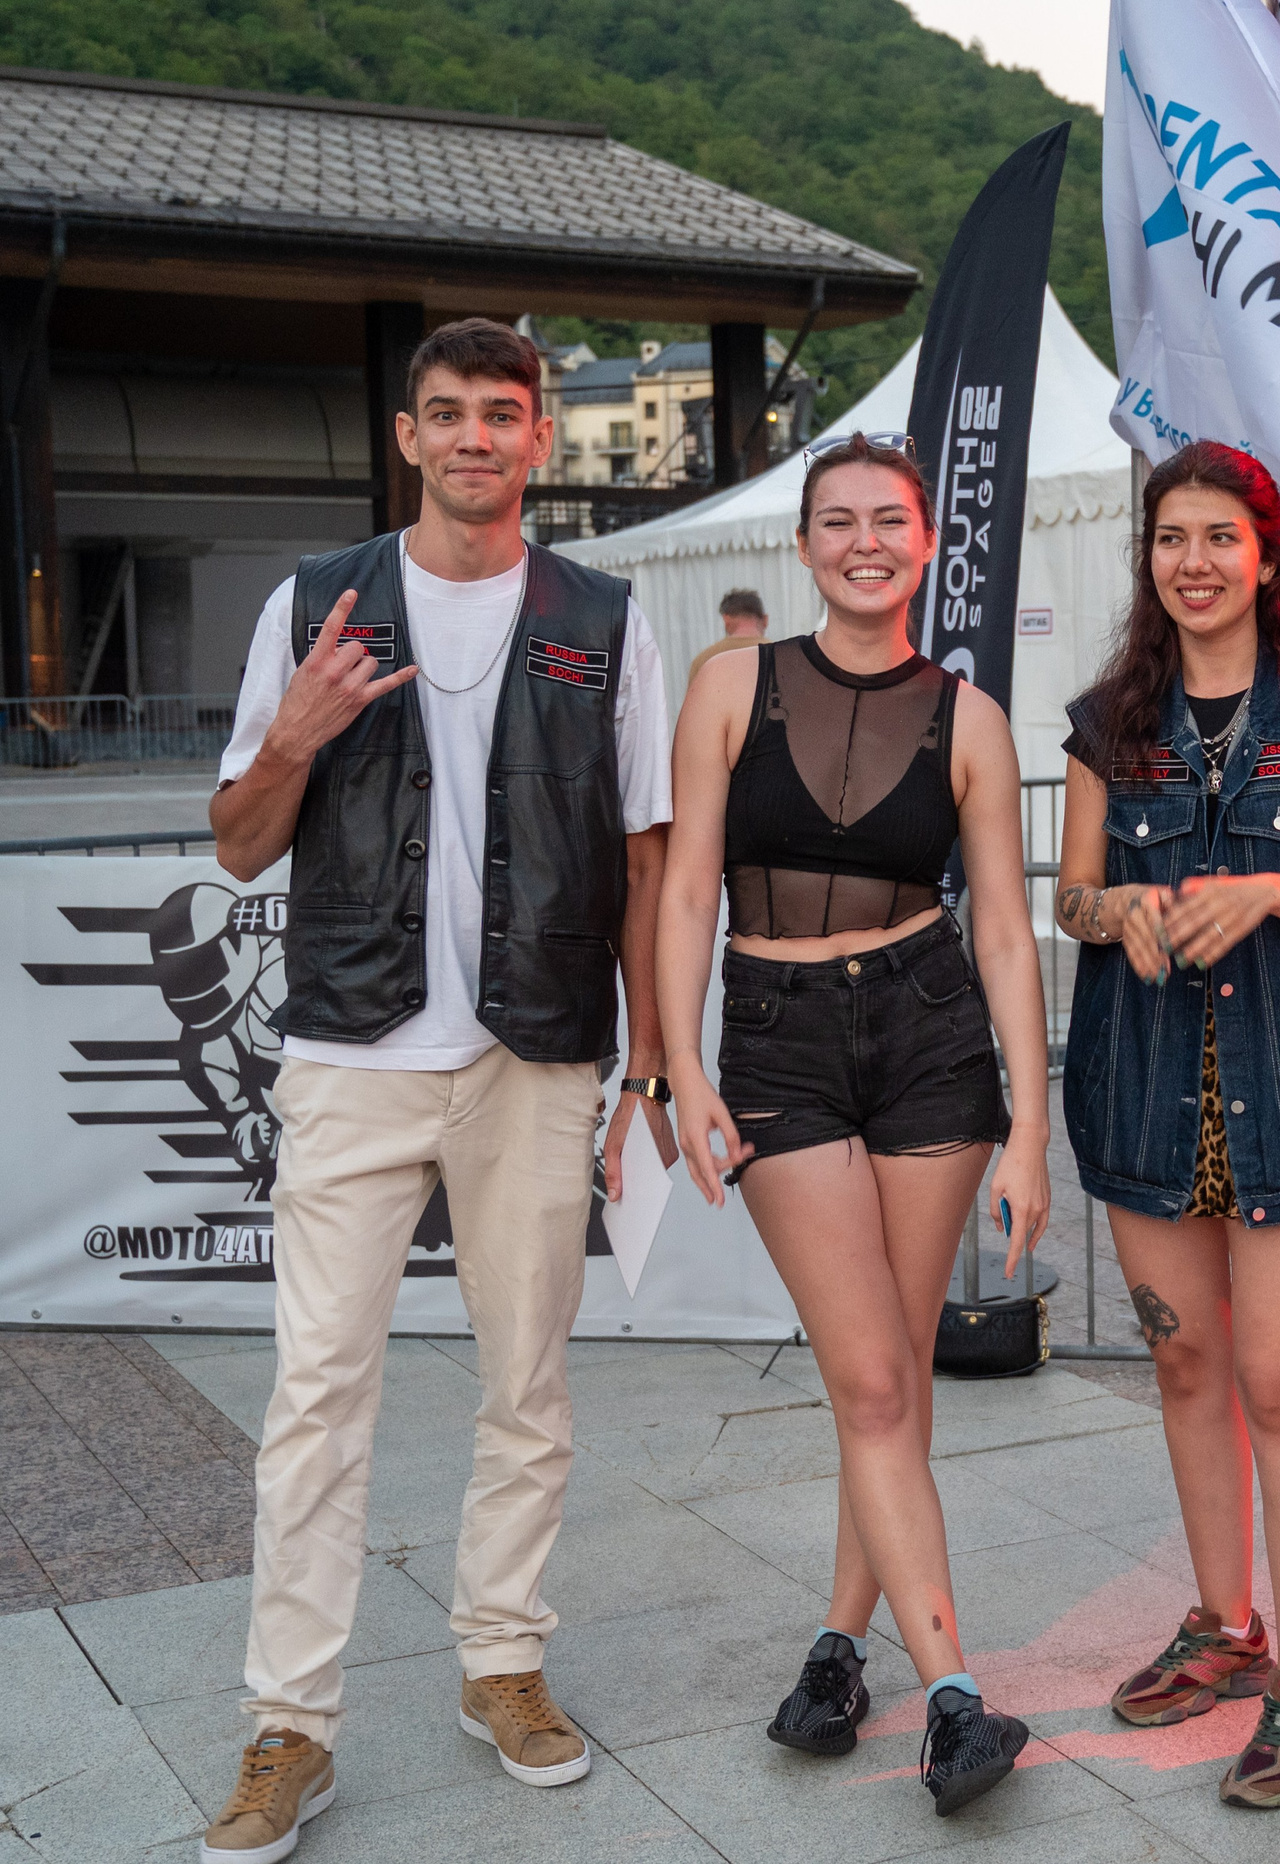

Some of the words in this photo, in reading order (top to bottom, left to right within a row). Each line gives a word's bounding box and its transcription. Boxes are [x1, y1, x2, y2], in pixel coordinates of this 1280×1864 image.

[959, 386, 1002, 431] PRO
[943, 437, 979, 632] SOUTH
[969, 441, 996, 628] STAGE
[340, 627, 374, 638] AZAKI
[545, 644, 588, 665] RUSSIA
[548, 665, 584, 684] SOCHI
